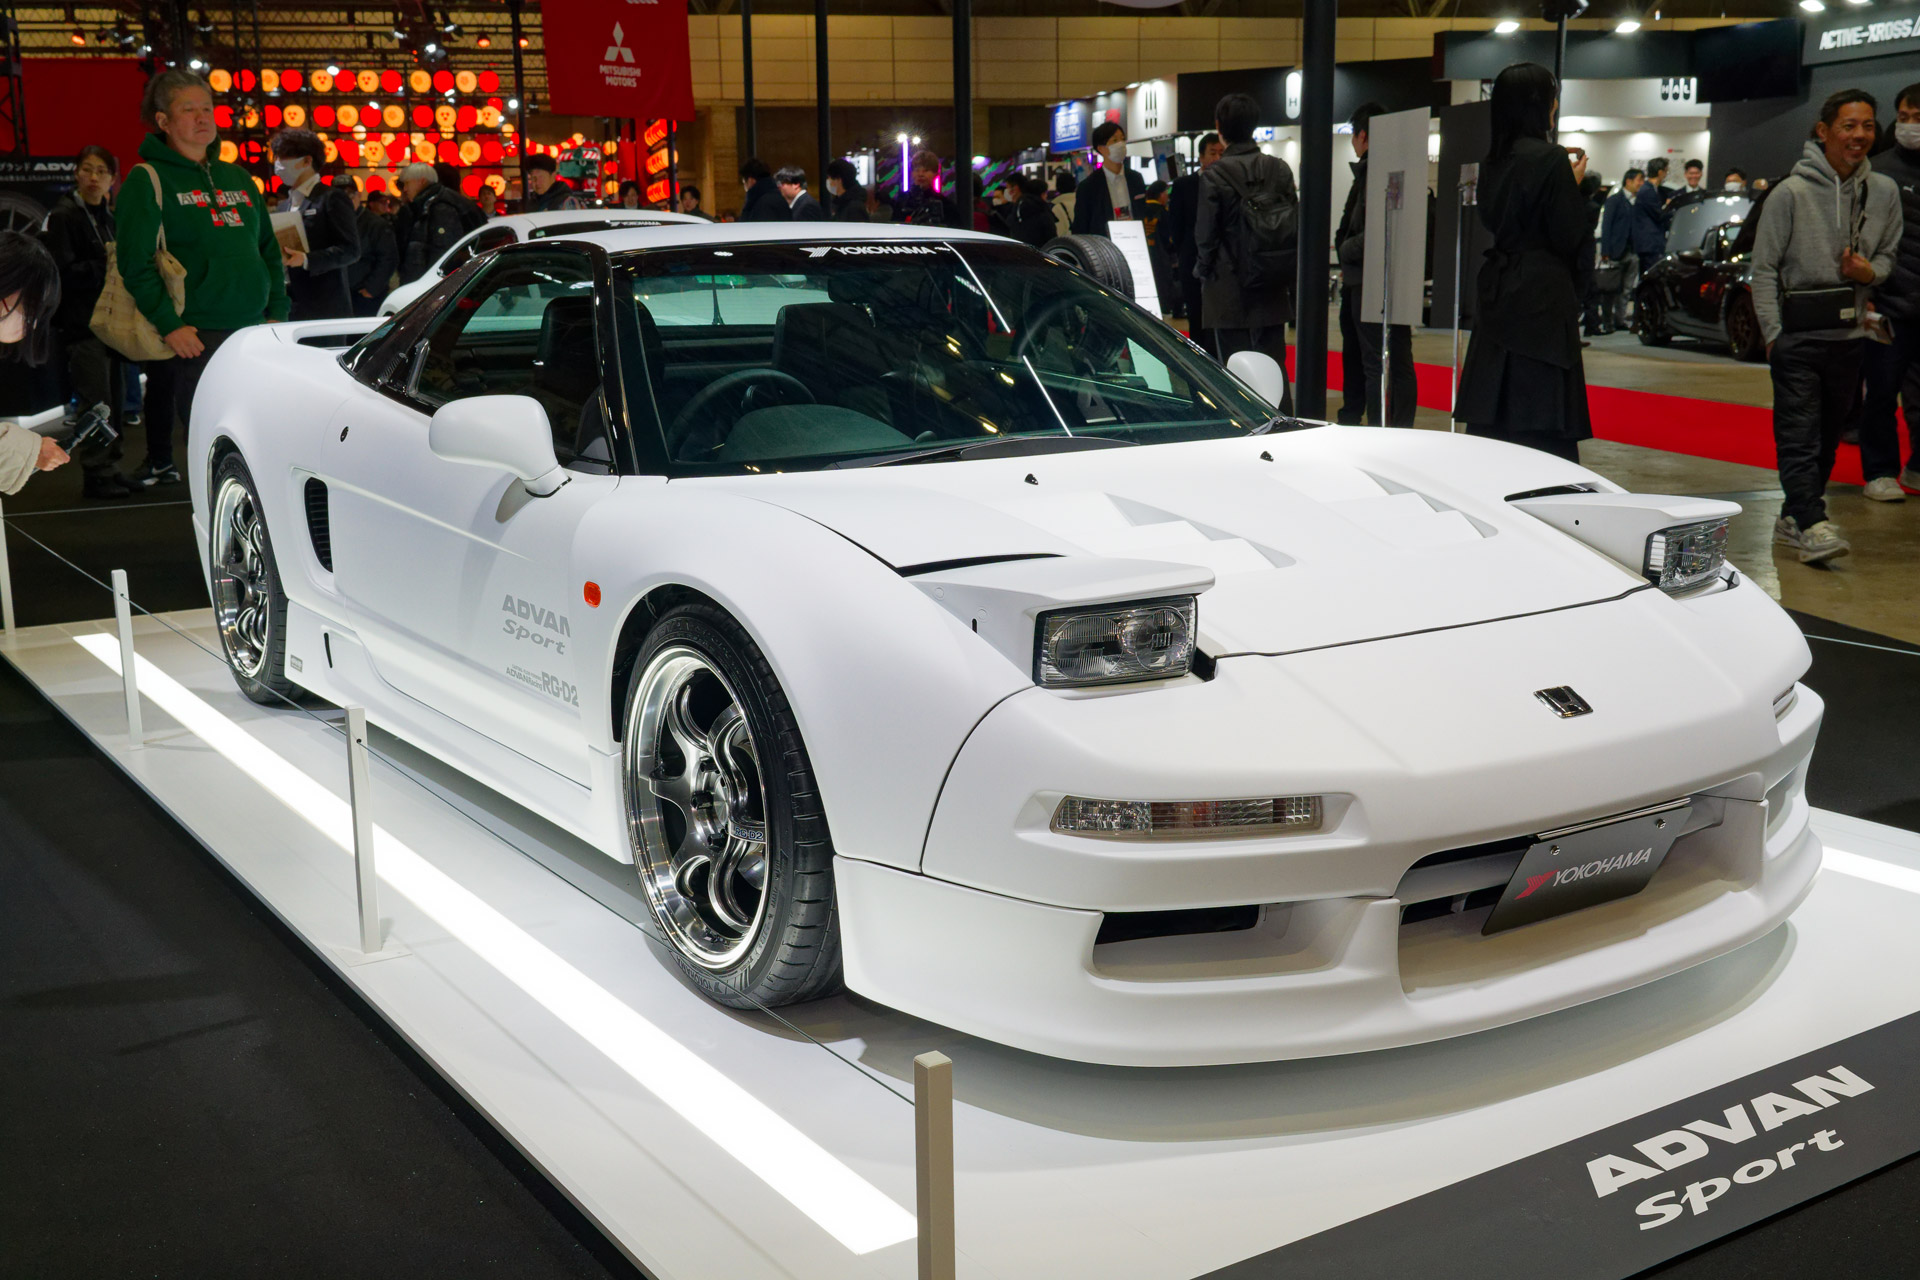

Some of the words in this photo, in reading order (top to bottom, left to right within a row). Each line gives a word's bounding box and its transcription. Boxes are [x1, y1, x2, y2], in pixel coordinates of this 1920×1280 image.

[599, 64, 642, 77] MITSUBISHI
[605, 76, 637, 87] MOTORS
[33, 162, 77, 171] ADV
[832, 246, 937, 255] YOKOHAMA
[502, 594, 571, 638] ADVAN
[502, 619, 565, 655] Sport
[542, 671, 579, 708] RG-D2
[1552, 847, 1653, 887] YOKOHAMA
[1585, 1064, 1876, 1198] ADVAN
[1634, 1128, 1845, 1231] Sport
